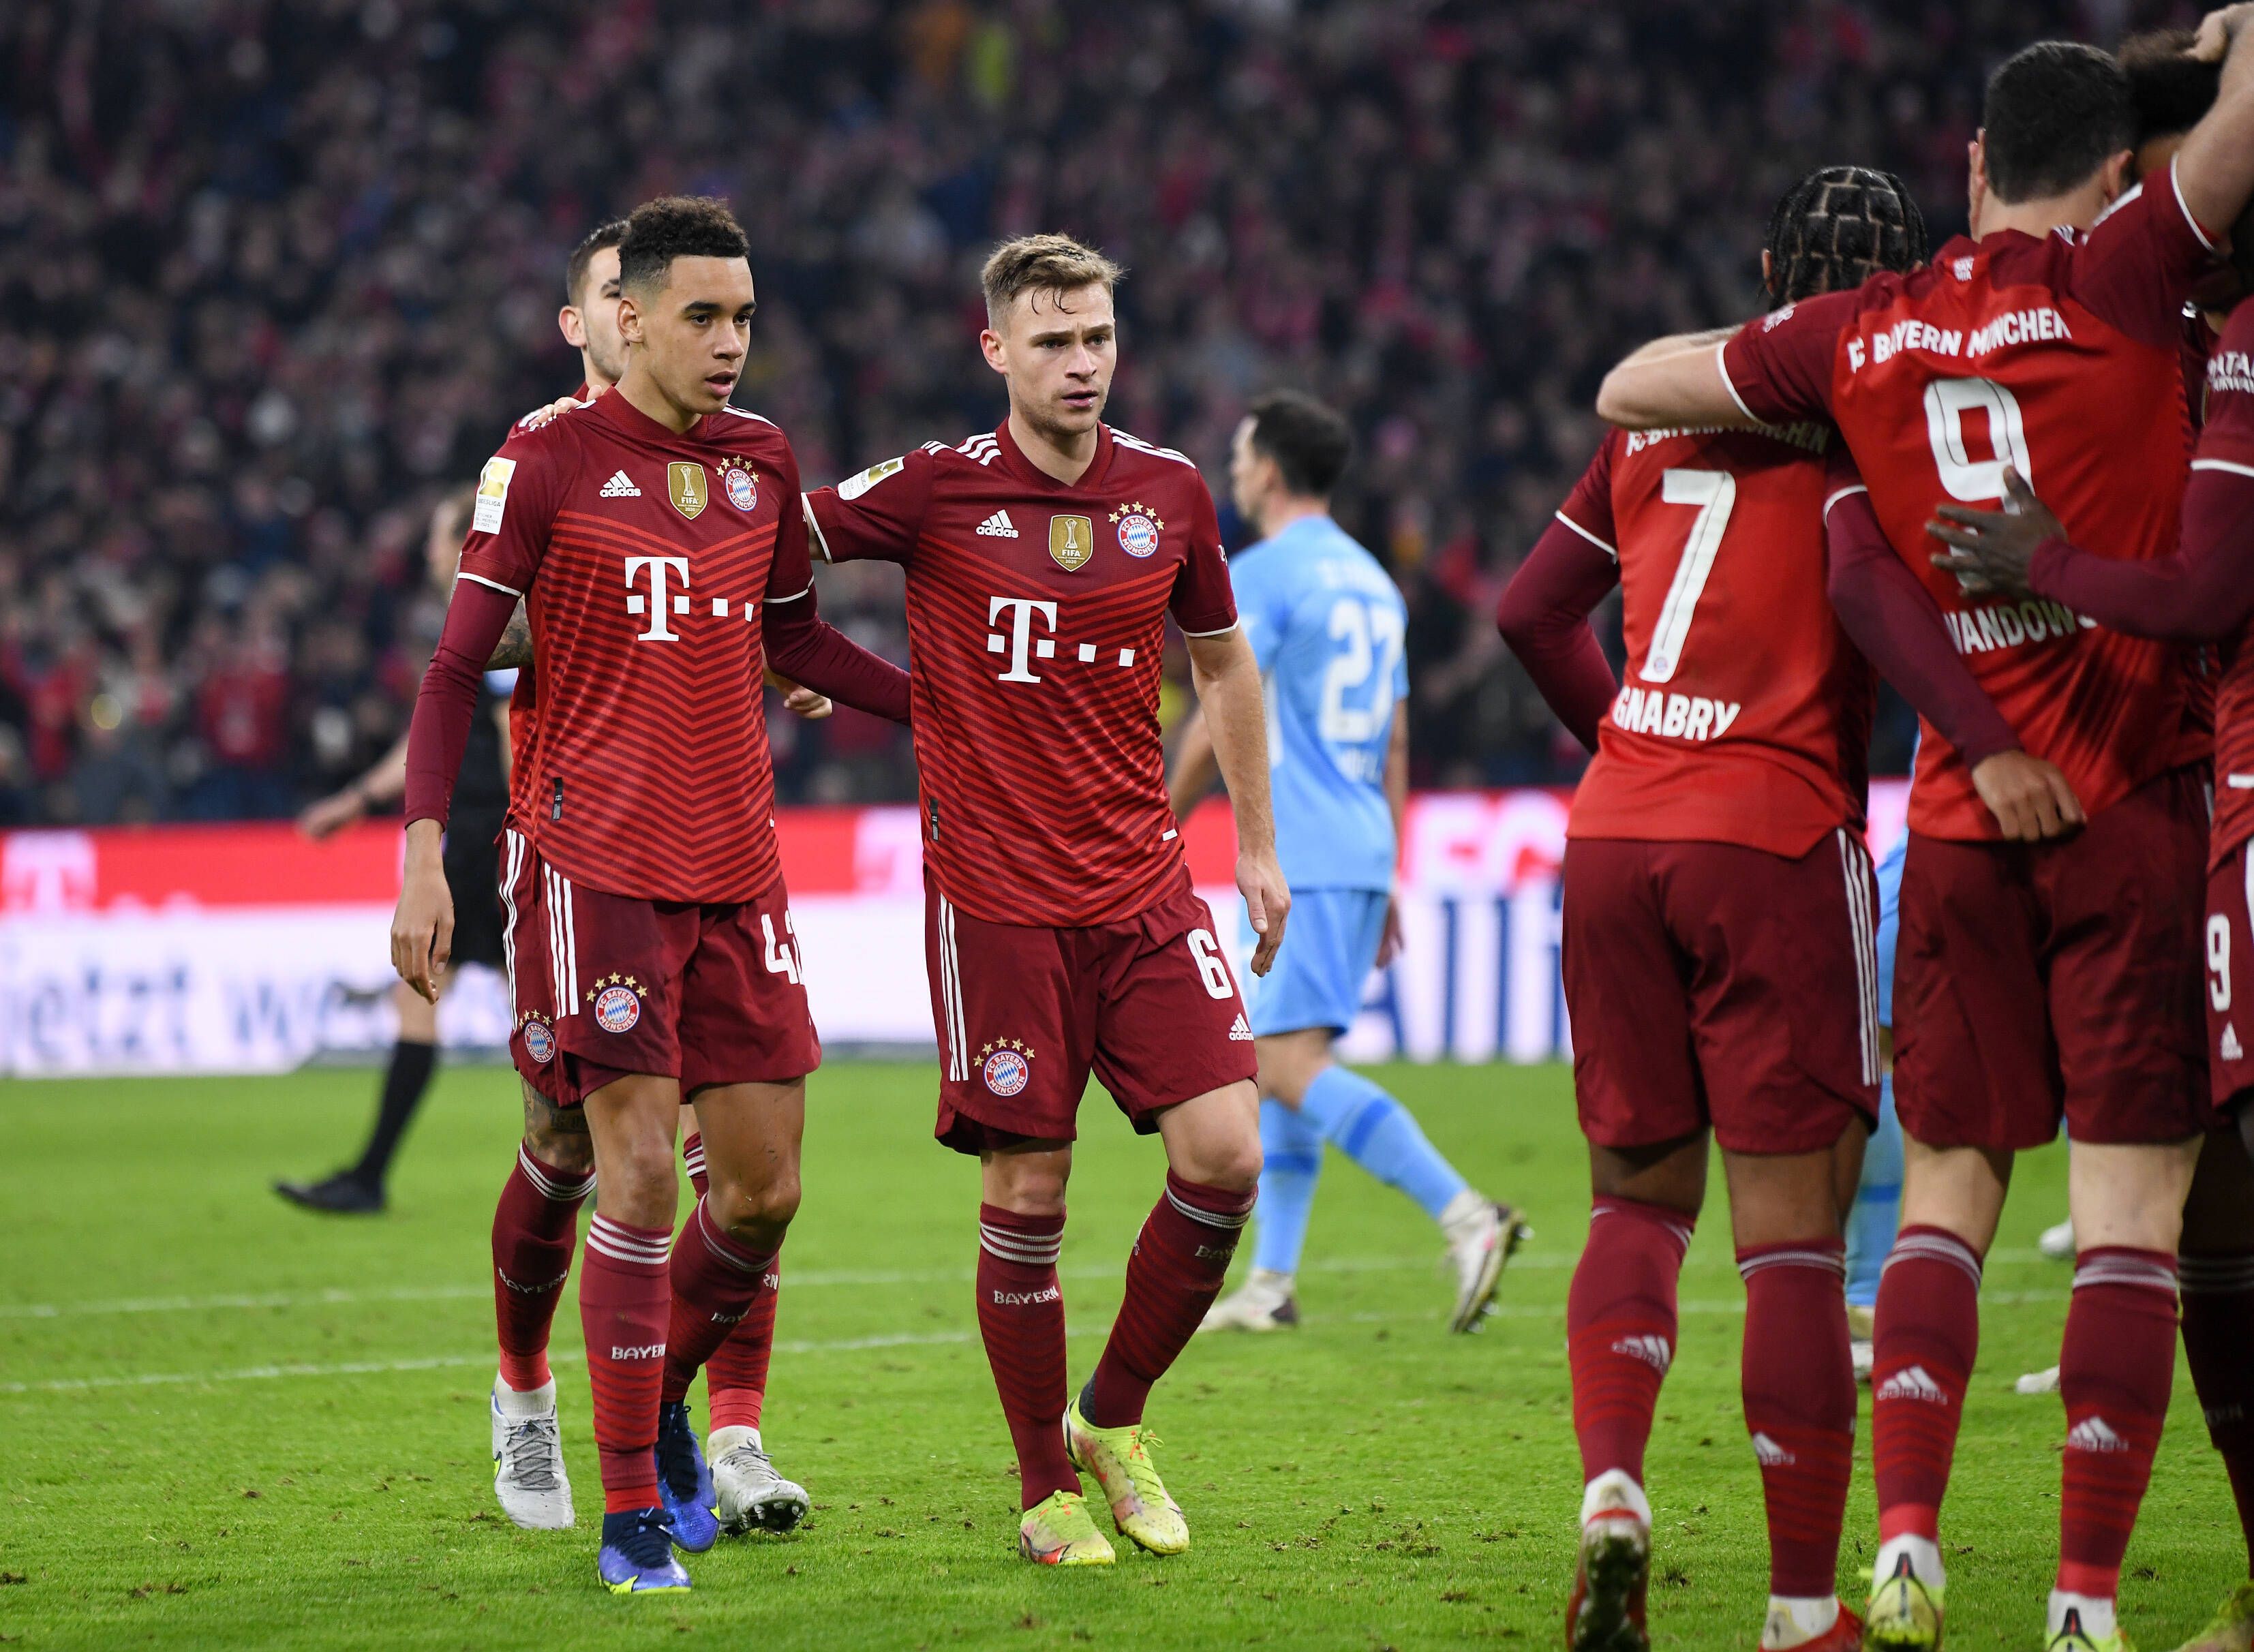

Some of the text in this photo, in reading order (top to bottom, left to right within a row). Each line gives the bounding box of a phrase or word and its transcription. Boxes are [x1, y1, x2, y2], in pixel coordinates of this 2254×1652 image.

[2207, 351, 2254, 378] ATA
[732, 471, 753, 488] BAYERN
[1923, 376, 2036, 590] 9
[600, 486, 641, 498] adidas
[976, 525, 1019, 538] adidas
[1122, 518, 1155, 536] FC BAYERN
[1639, 469, 1736, 684] 7
[1316, 597, 1405, 744] 27
[1613, 685, 1741, 741] GNABRY
[1187, 928, 1234, 1000] 6
[599, 990, 636, 1009] FC BAYERN
[530, 1025, 552, 1043] BAYERN
[987, 1054, 1024, 1073] FC BAYERN
[994, 1285, 1059, 1305] BAYERN
